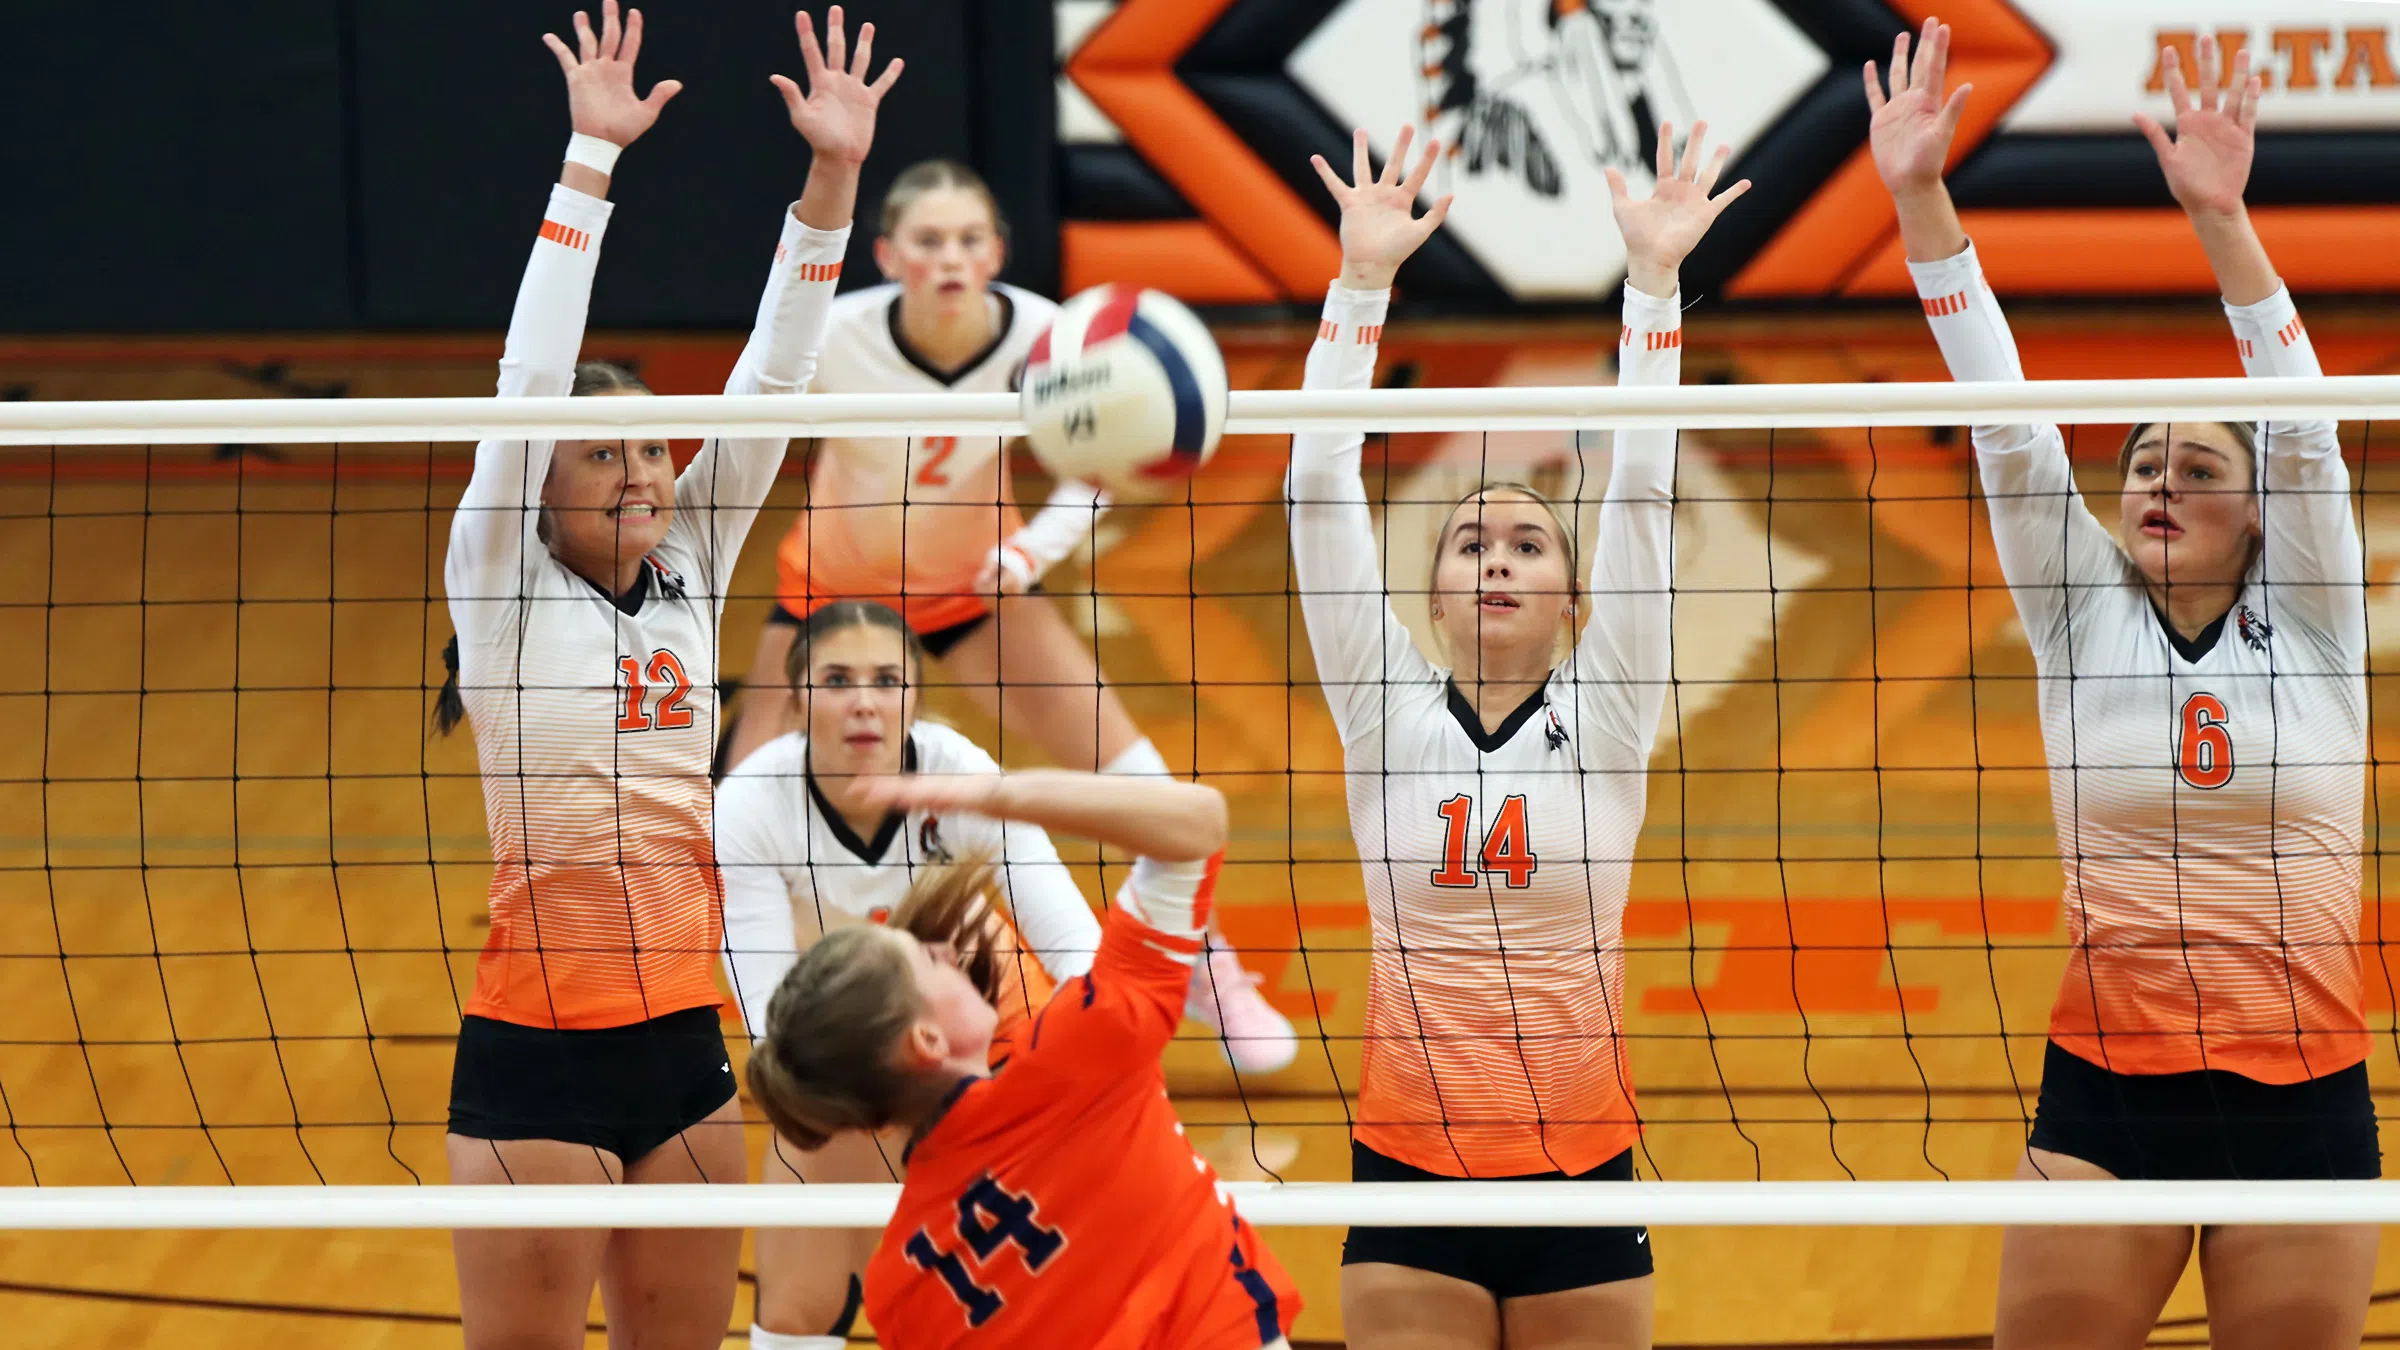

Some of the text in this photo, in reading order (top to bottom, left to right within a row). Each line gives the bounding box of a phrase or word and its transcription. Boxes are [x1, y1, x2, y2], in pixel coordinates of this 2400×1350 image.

[914, 436, 959, 487] 2
[617, 648, 694, 733] 12
[2177, 692, 2235, 790] 6
[1431, 793, 1537, 889] 14
[903, 1170, 1068, 1329] 14
